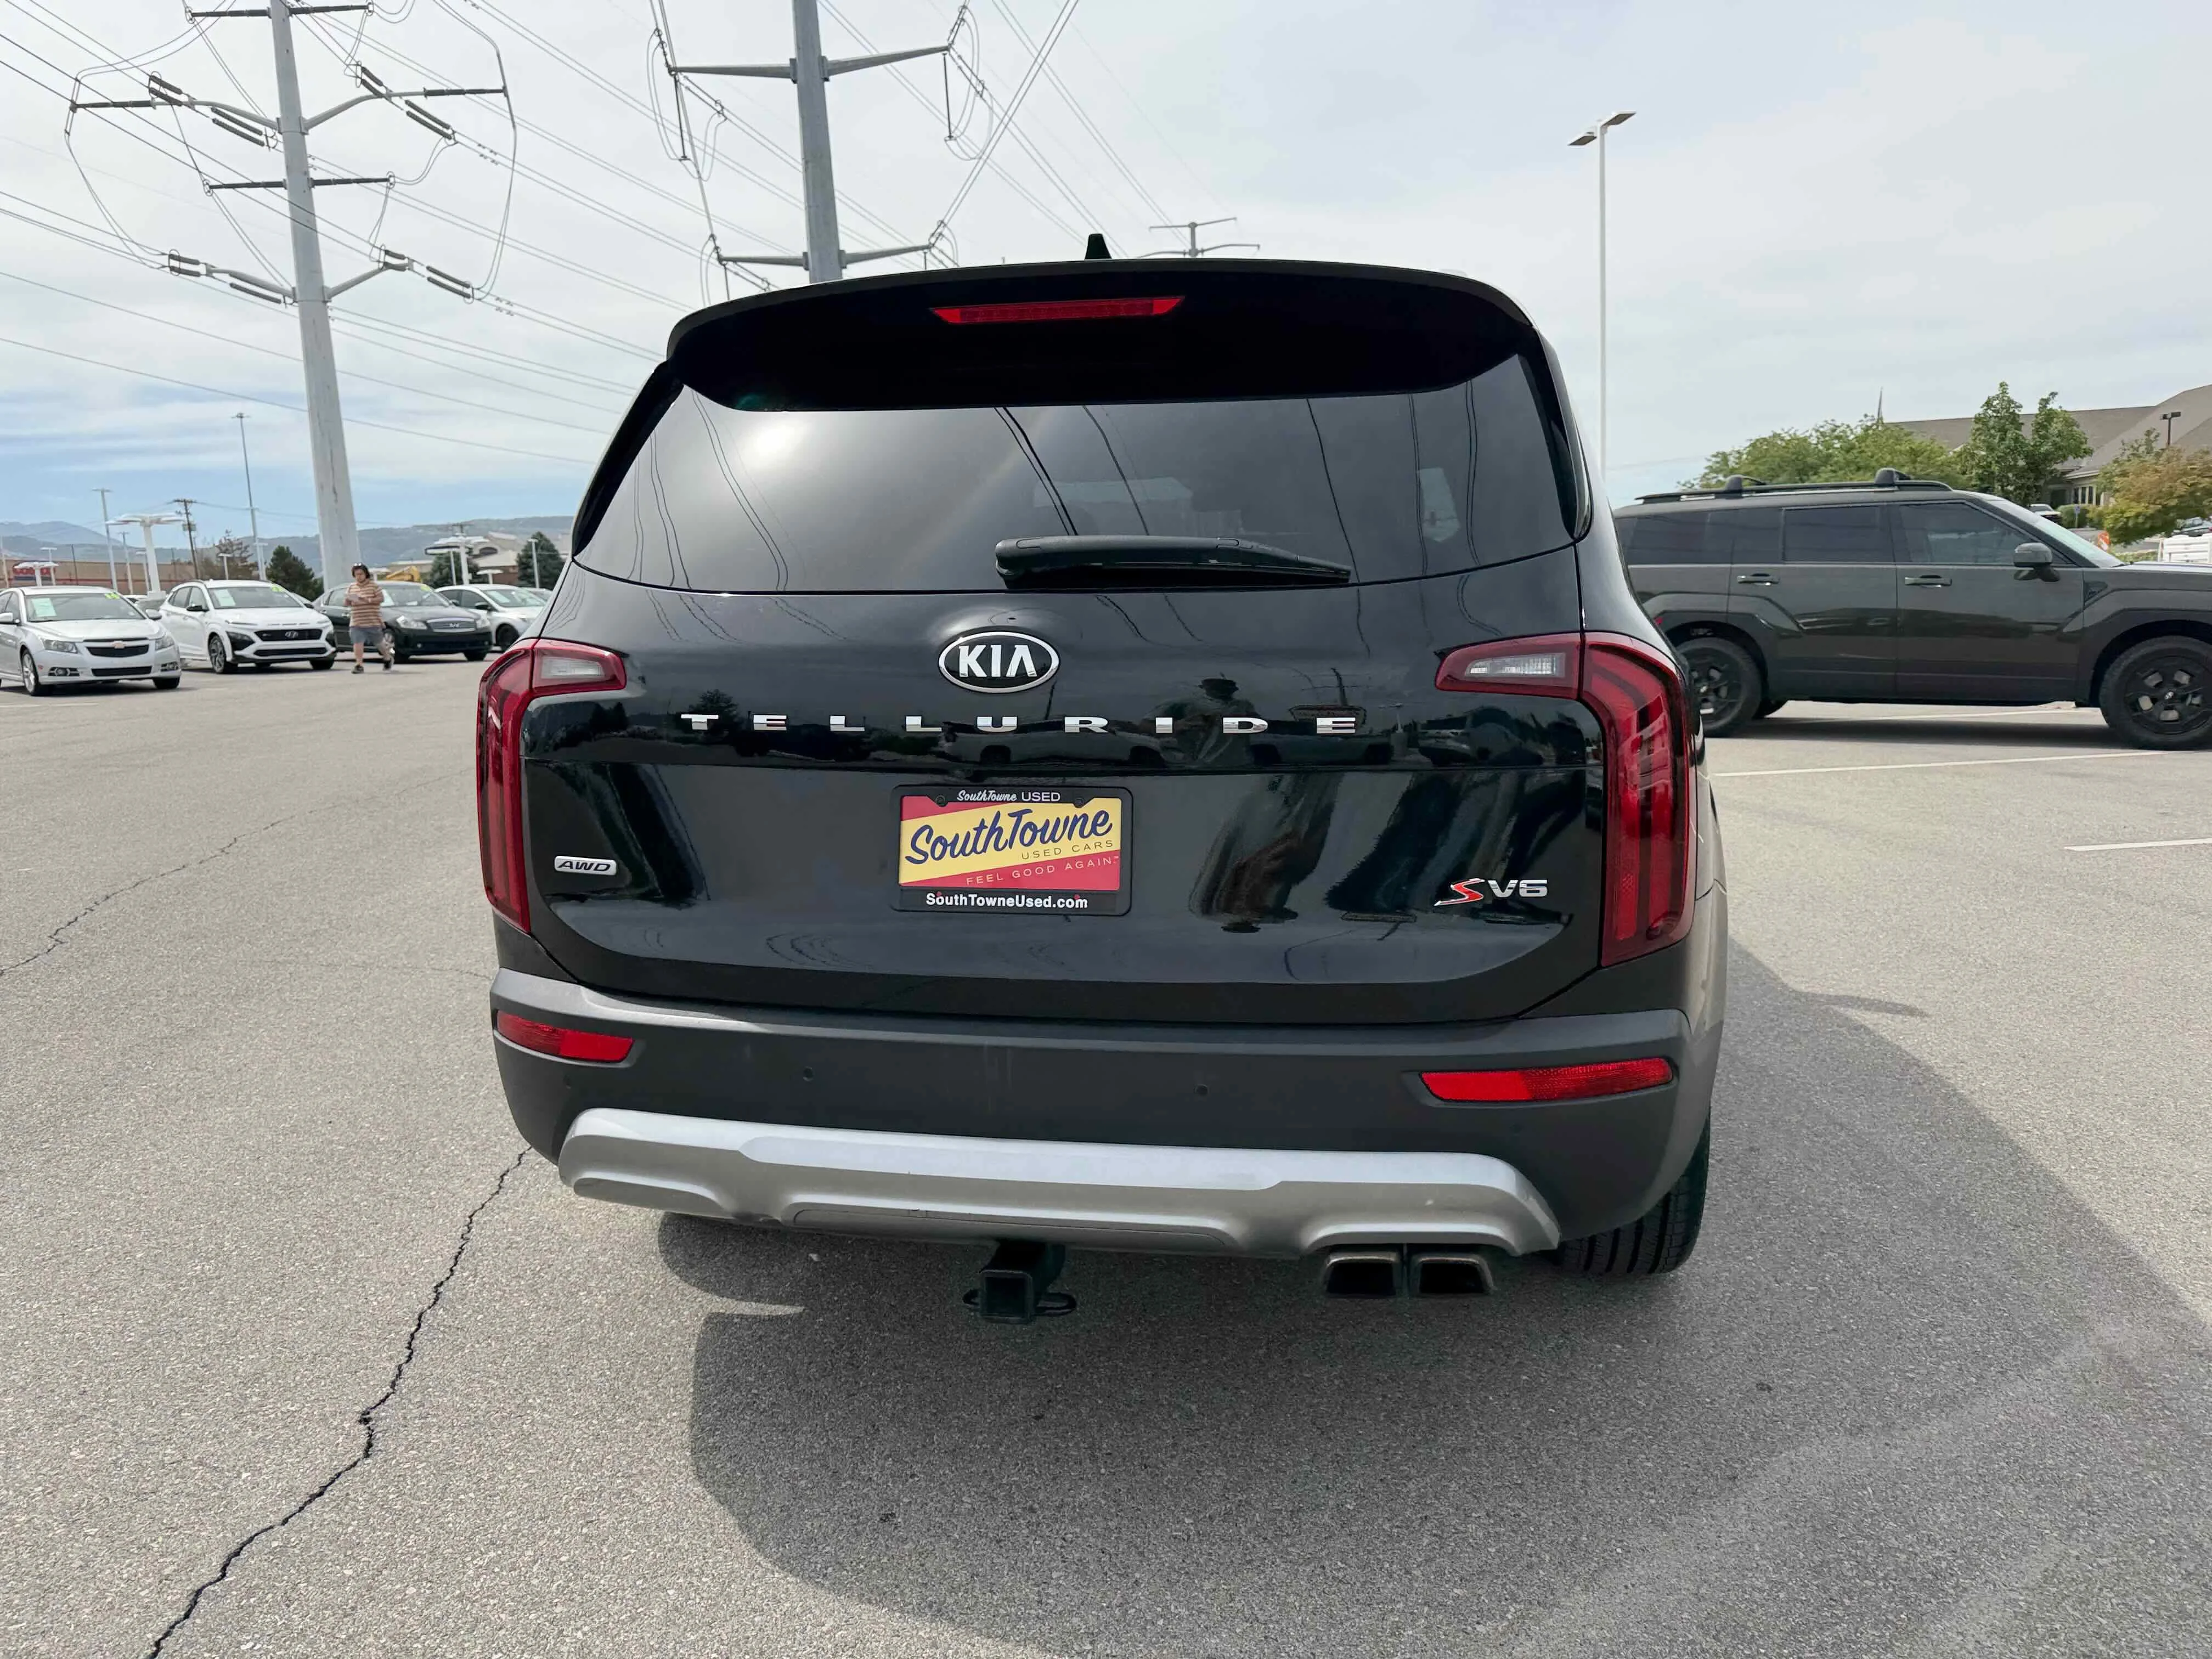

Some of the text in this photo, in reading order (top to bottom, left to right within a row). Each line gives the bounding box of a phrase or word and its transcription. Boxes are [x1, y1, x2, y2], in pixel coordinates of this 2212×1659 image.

[958, 645, 1037, 678] KIA
[681, 714, 1356, 734] TELLURIDE
[956, 789, 1061, 802] SouthTowne USED
[905, 808, 1113, 865] SouthTowne
[1021, 840, 1114, 860] USED CARS
[558, 860, 611, 871] AWD
[966, 873, 1003, 885] FEEL
[1012, 865, 1055, 879] GOOD
[926, 893, 1088, 909] SouthTowneUsed.com
